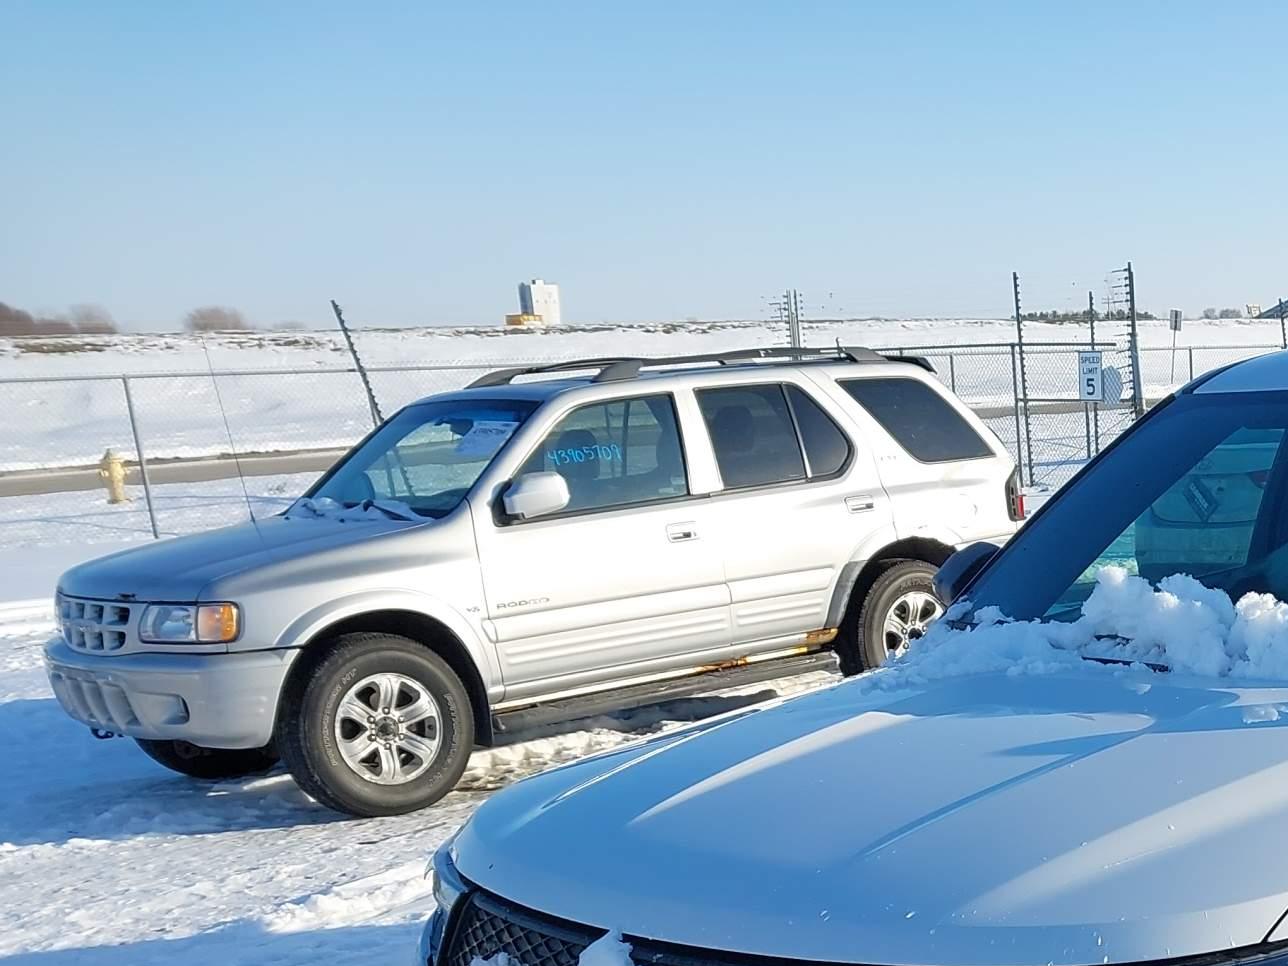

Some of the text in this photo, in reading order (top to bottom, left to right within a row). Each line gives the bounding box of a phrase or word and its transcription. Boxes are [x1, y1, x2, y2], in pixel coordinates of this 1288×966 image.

[1080, 356, 1100, 364] SPEED
[1082, 367, 1098, 375] LIMIT
[1086, 378, 1096, 396] 5
